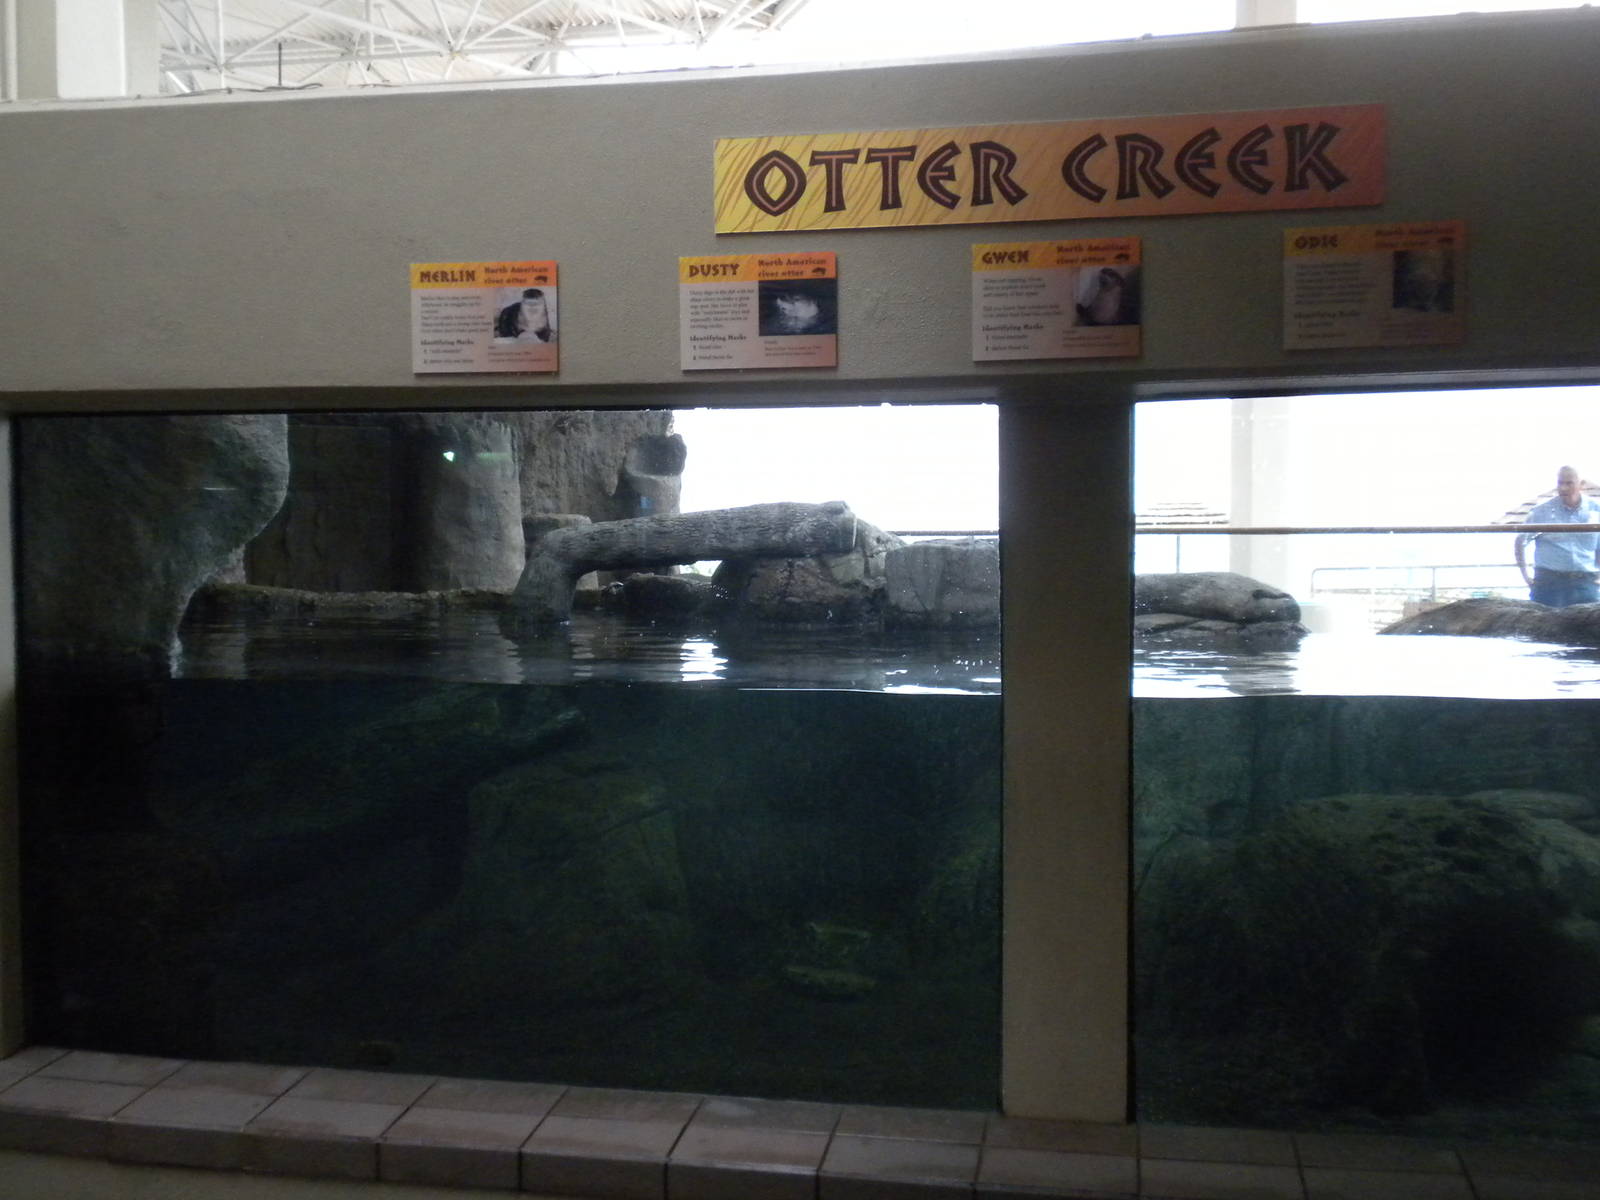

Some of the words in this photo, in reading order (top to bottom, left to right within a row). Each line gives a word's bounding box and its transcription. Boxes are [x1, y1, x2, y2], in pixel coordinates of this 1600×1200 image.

[744, 140, 1028, 217] OTTER
[1061, 121, 1349, 203] CREEK
[757, 259, 784, 267] North
[786, 257, 827, 266] American
[981, 250, 1030, 265] GWEN
[419, 269, 476, 283] MERLIN
[484, 266, 508, 274] North
[510, 265, 549, 273] American
[688, 263, 740, 278] DUSTY
[757, 269, 779, 277] river
[781, 269, 804, 277] otter
